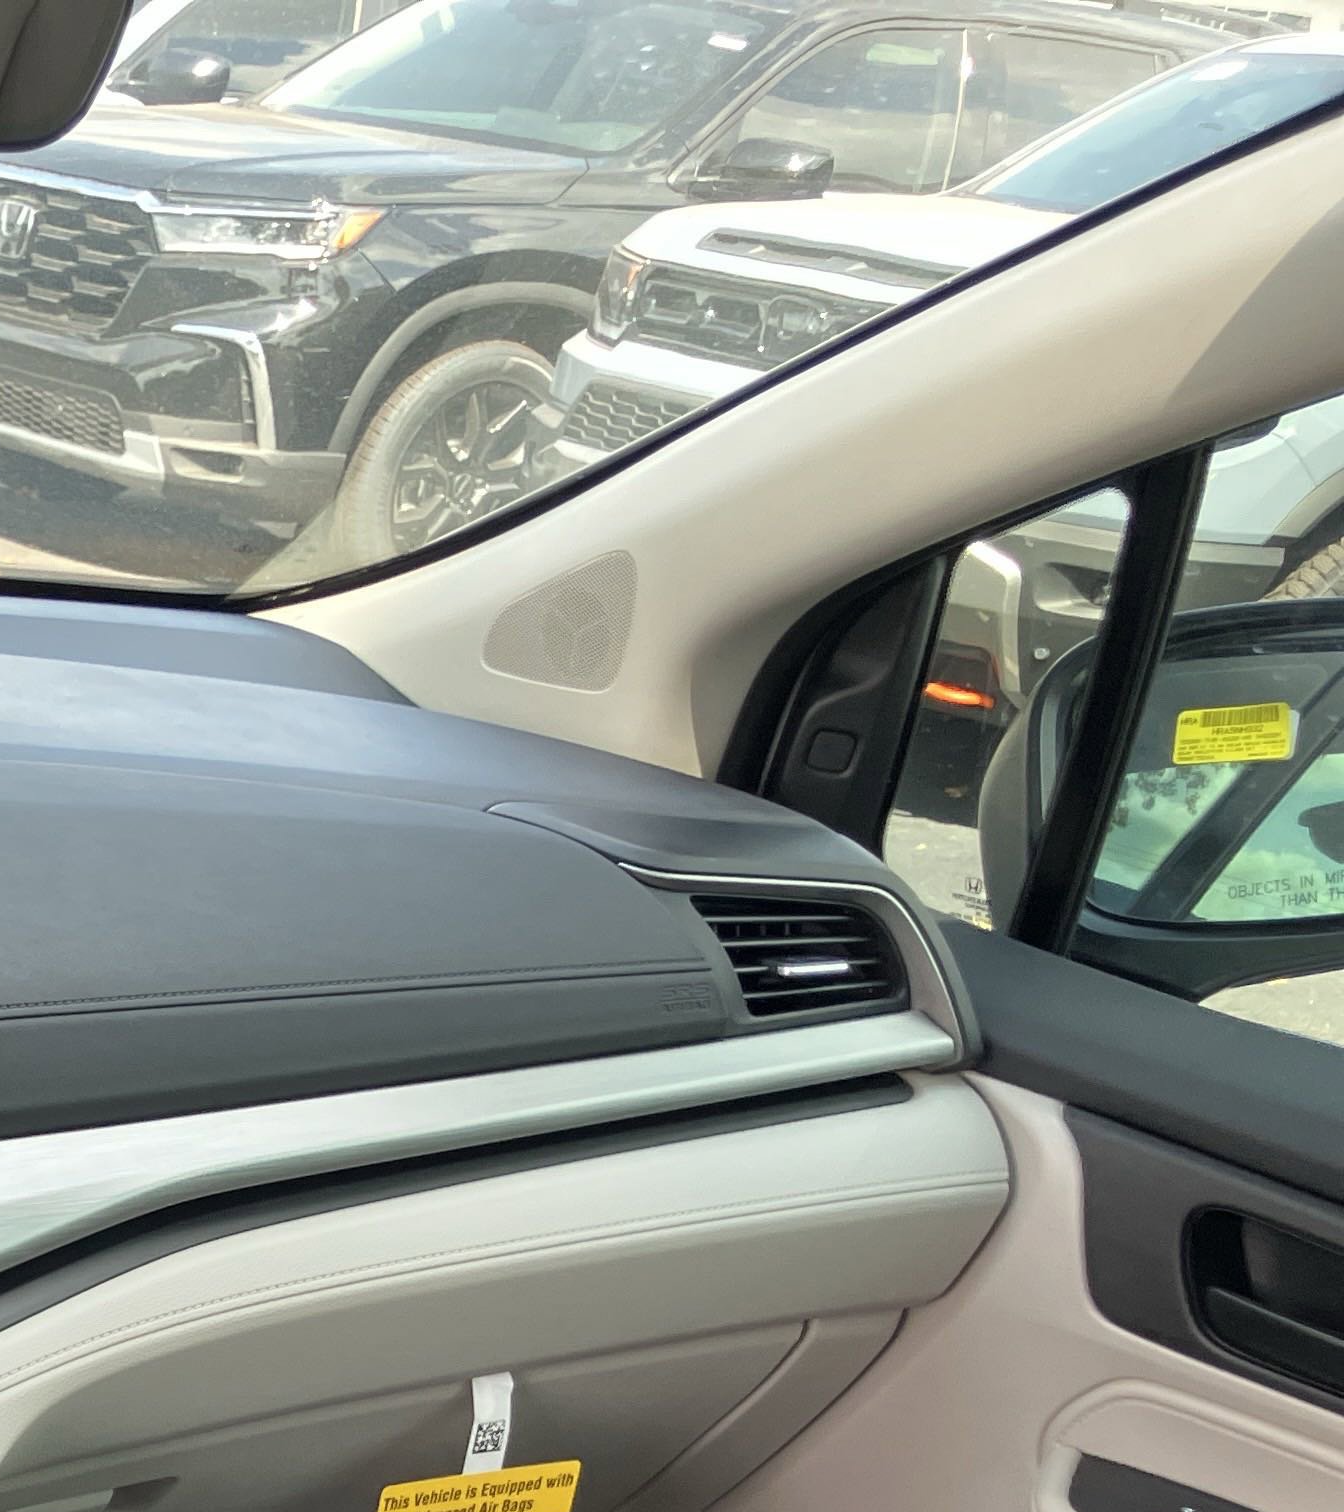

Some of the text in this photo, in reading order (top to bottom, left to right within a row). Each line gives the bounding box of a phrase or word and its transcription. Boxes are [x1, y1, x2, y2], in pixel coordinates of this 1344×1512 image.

[1228, 878, 1291, 899] OBJECTS
[1299, 875, 1314, 889] IN
[1280, 890, 1318, 908] THAN
[383, 1473, 574, 1512] This Vehicle is Equipped with
[501, 1498, 534, 1512] Bags
